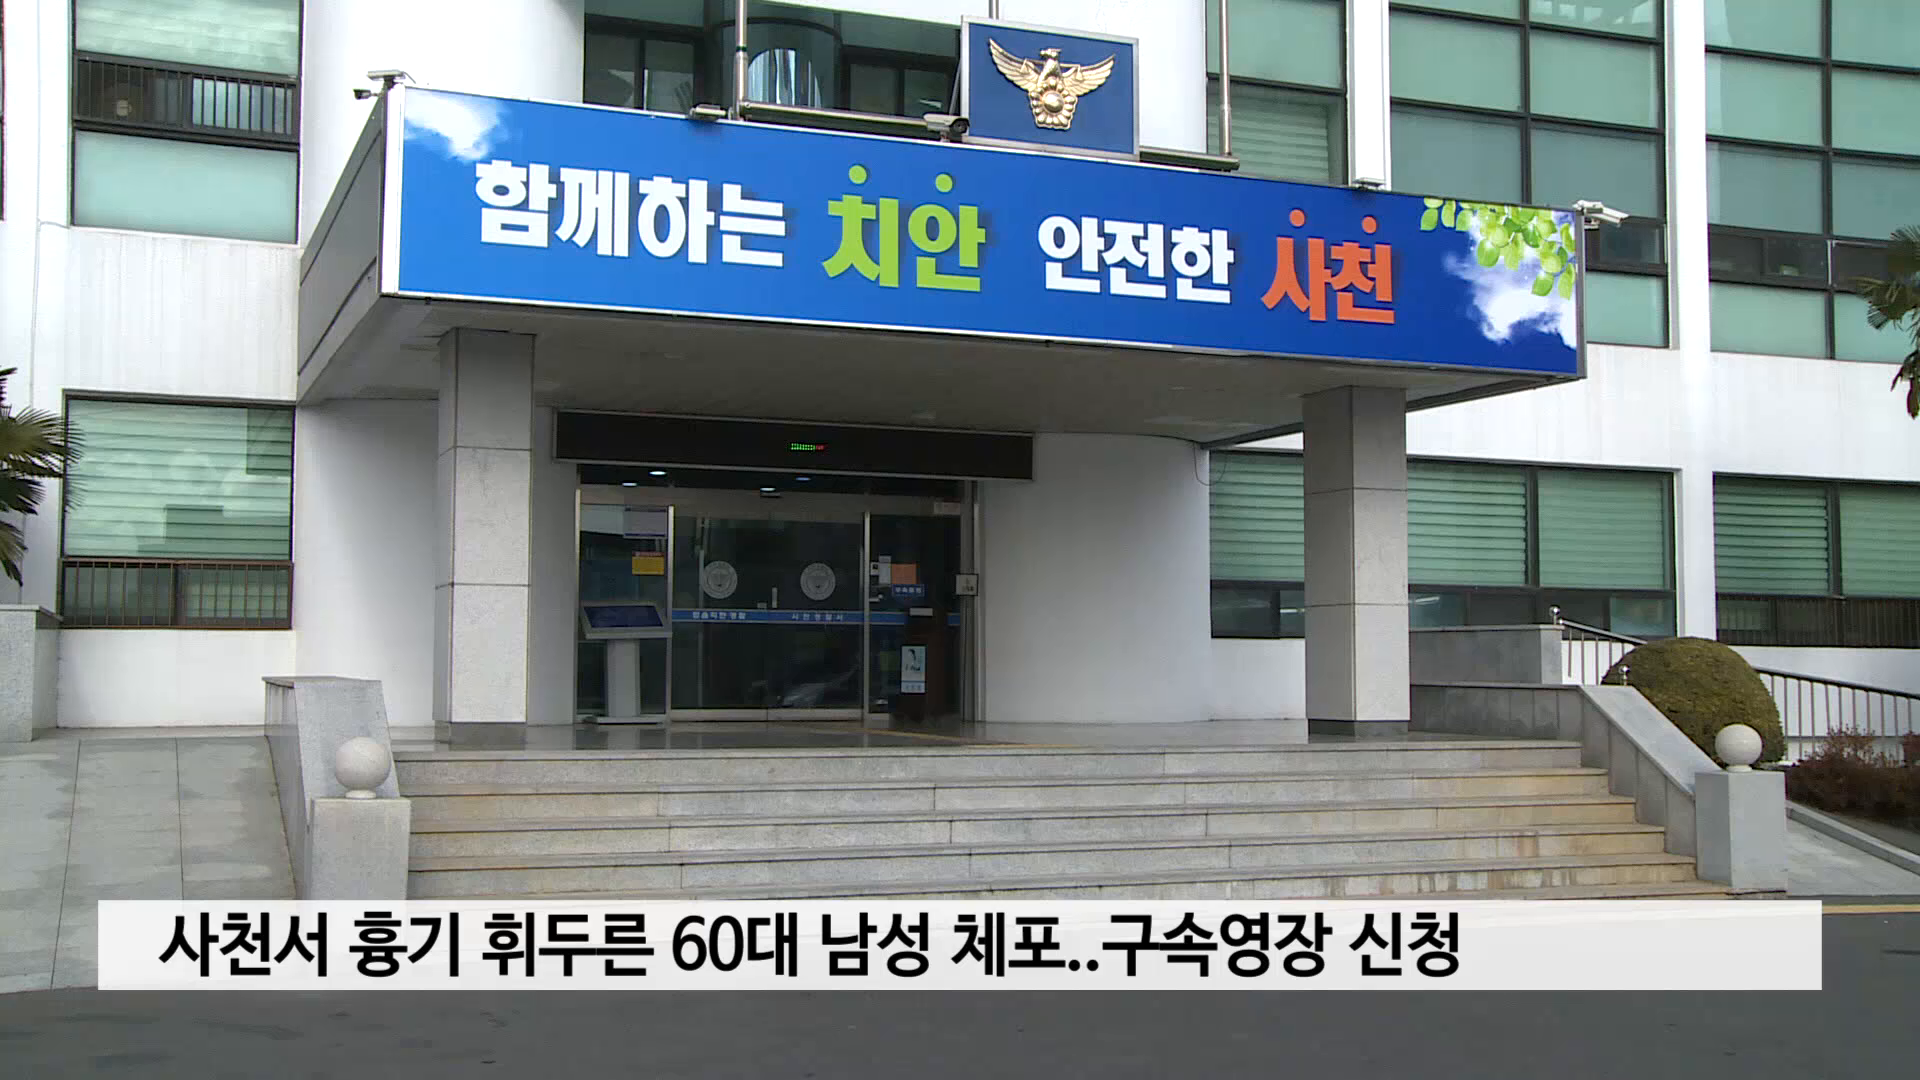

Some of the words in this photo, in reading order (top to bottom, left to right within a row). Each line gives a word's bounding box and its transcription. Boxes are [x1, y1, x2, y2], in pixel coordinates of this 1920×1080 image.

[474, 158, 787, 268] 함께하는
[821, 164, 987, 292] 치안
[1036, 214, 1235, 305] 안전한
[1261, 209, 1396, 324] 사천
